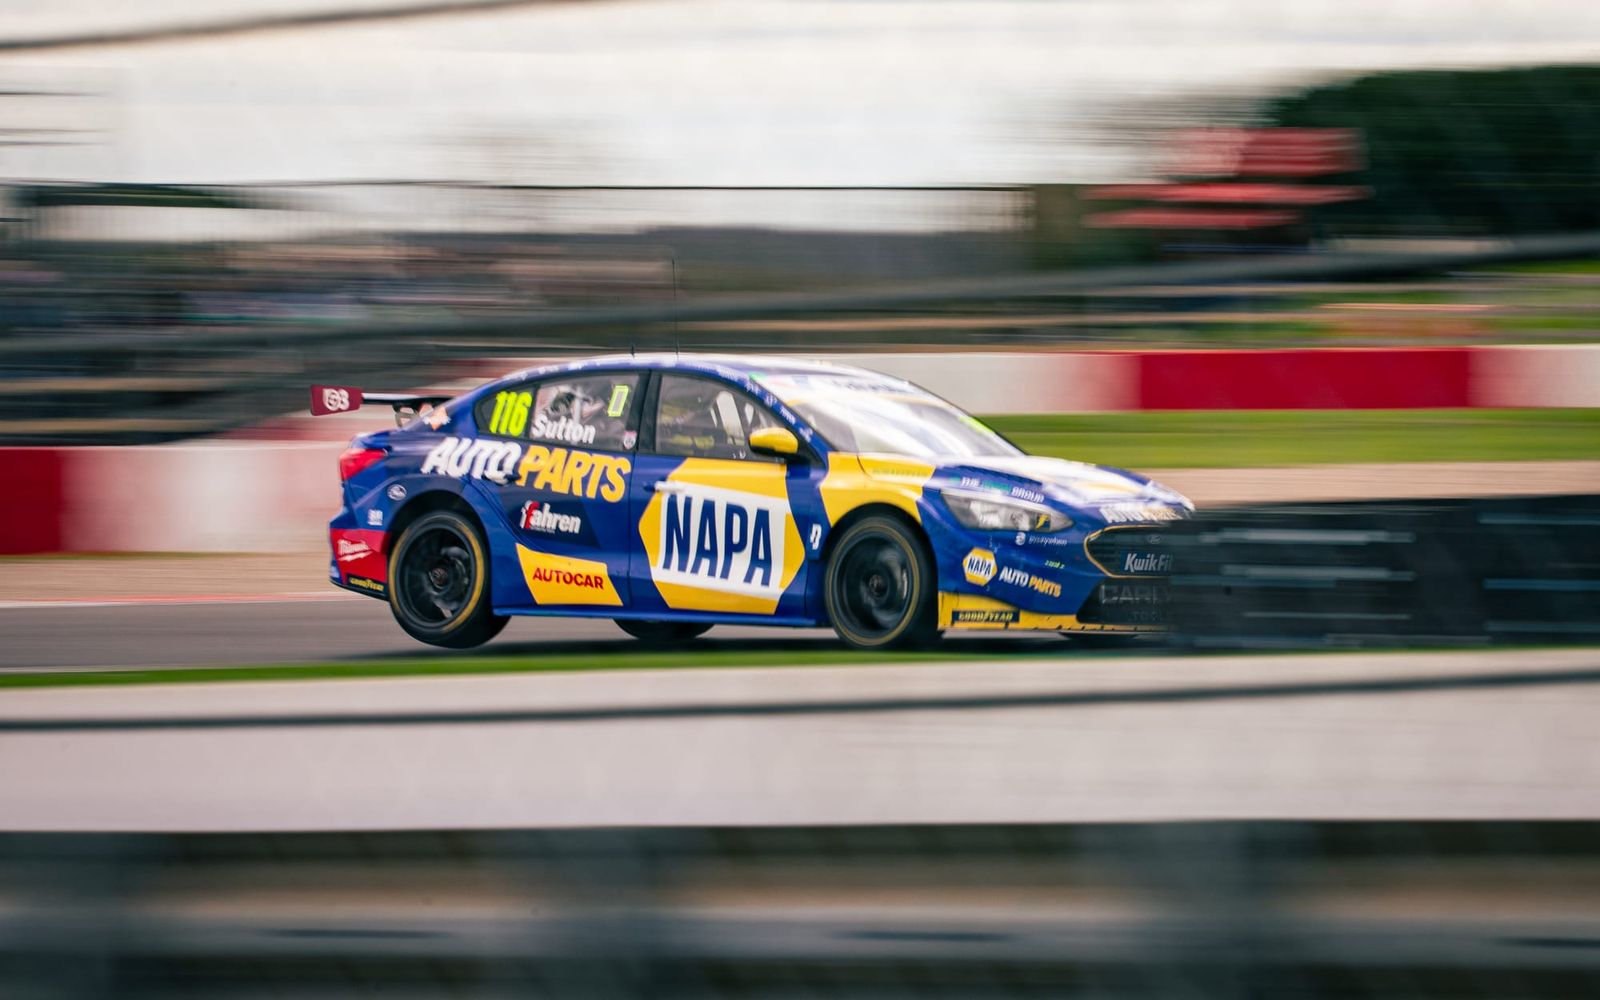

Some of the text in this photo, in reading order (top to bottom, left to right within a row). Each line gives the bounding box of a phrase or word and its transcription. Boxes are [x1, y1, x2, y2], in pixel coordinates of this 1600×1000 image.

[490, 391, 532, 436] 116
[532, 413, 596, 444] Sutton
[420, 437, 631, 502] AUTO PARTS
[520, 500, 581, 534] fahren
[662, 494, 772, 587] NAPA
[533, 567, 604, 589] AUTOCAR
[967, 557, 992, 575] NAPA
[999, 566, 1062, 598] AUTO PARTS
